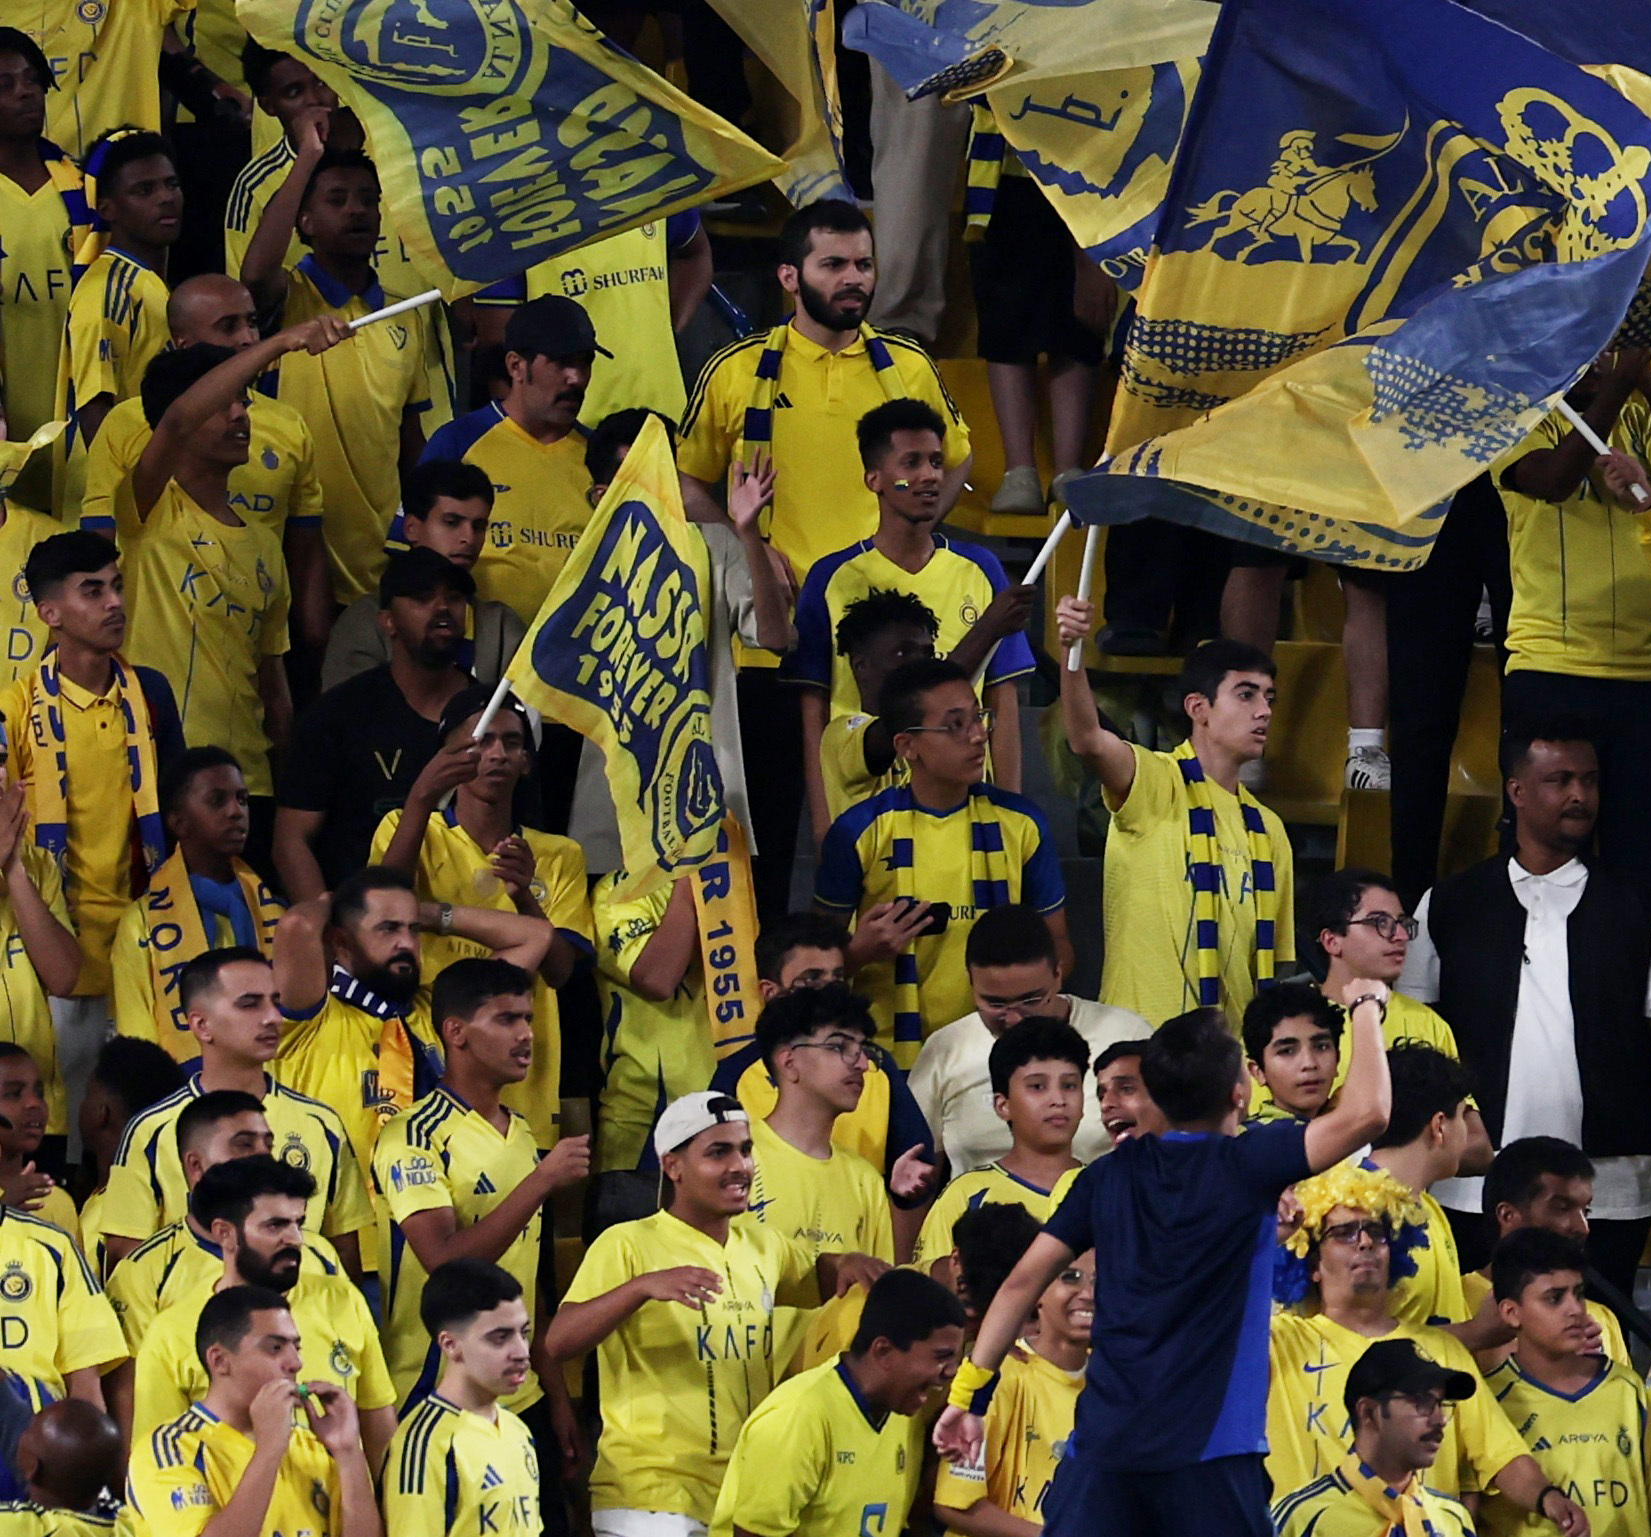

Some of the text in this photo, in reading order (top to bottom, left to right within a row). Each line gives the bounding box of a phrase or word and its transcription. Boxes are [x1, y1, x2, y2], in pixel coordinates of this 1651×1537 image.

[1458, 155, 1522, 223] AL
[519, 527, 580, 549] SHURF
[703, 917, 745, 1024] 1955
[696, 1324, 773, 1362] KAFD
